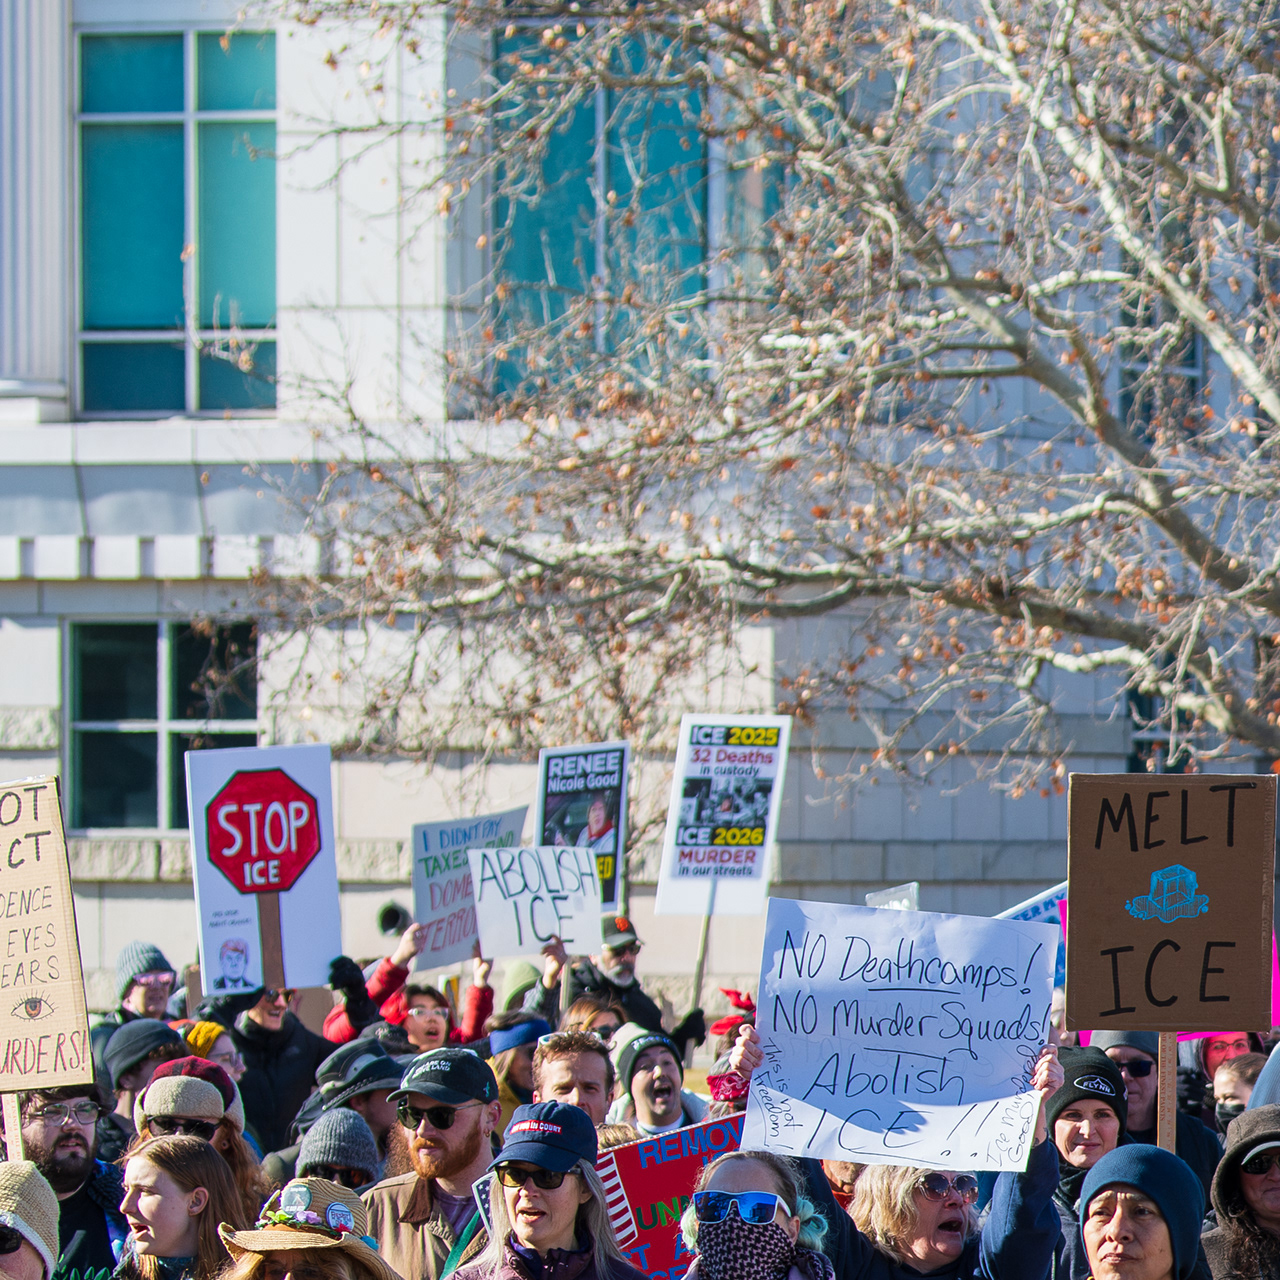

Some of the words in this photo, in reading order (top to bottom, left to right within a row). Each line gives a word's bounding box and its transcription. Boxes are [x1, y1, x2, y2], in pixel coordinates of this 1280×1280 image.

[691, 726, 726, 744] ICE
[727, 727, 779, 745] 2025
[549, 751, 621, 777] RENEE
[691, 749, 711, 763] 32
[715, 749, 774, 764] Deaths
[700, 765, 710, 775] in
[714, 765, 759, 777] custody
[547, 775, 585, 793] Nicole
[586, 771, 619, 788] Good
[217, 801, 310, 857] STOP
[1095, 782, 1257, 852] MELT
[677, 827, 711, 845] ICE
[713, 828, 764, 845] 2026
[678, 849, 756, 864] MURDER
[678, 865, 689, 875] in
[692, 866, 711, 876] our
[713, 865, 753, 876] streets
[243, 860, 280, 887] ICE
[478, 849, 597, 902] ABOLISH
[512, 895, 574, 946] ICE
[7, 923, 56, 958] EYES
[1, 955, 60, 990] EARS
[778, 930, 827, 980] NO
[839, 936, 1043, 1002] Deathcamps!
[1099, 939, 1236, 1017] ICE
[773, 989, 818, 1036] NO
[832, 1000, 938, 1038] Murder
[938, 1001, 1052, 1060] Squads!
[801, 1052, 965, 1107] Abolish
[1083, 1081, 1111, 1094] FLYNN
[539, 1122, 561, 1133] COURT
[779, 1098, 803, 1133] not
